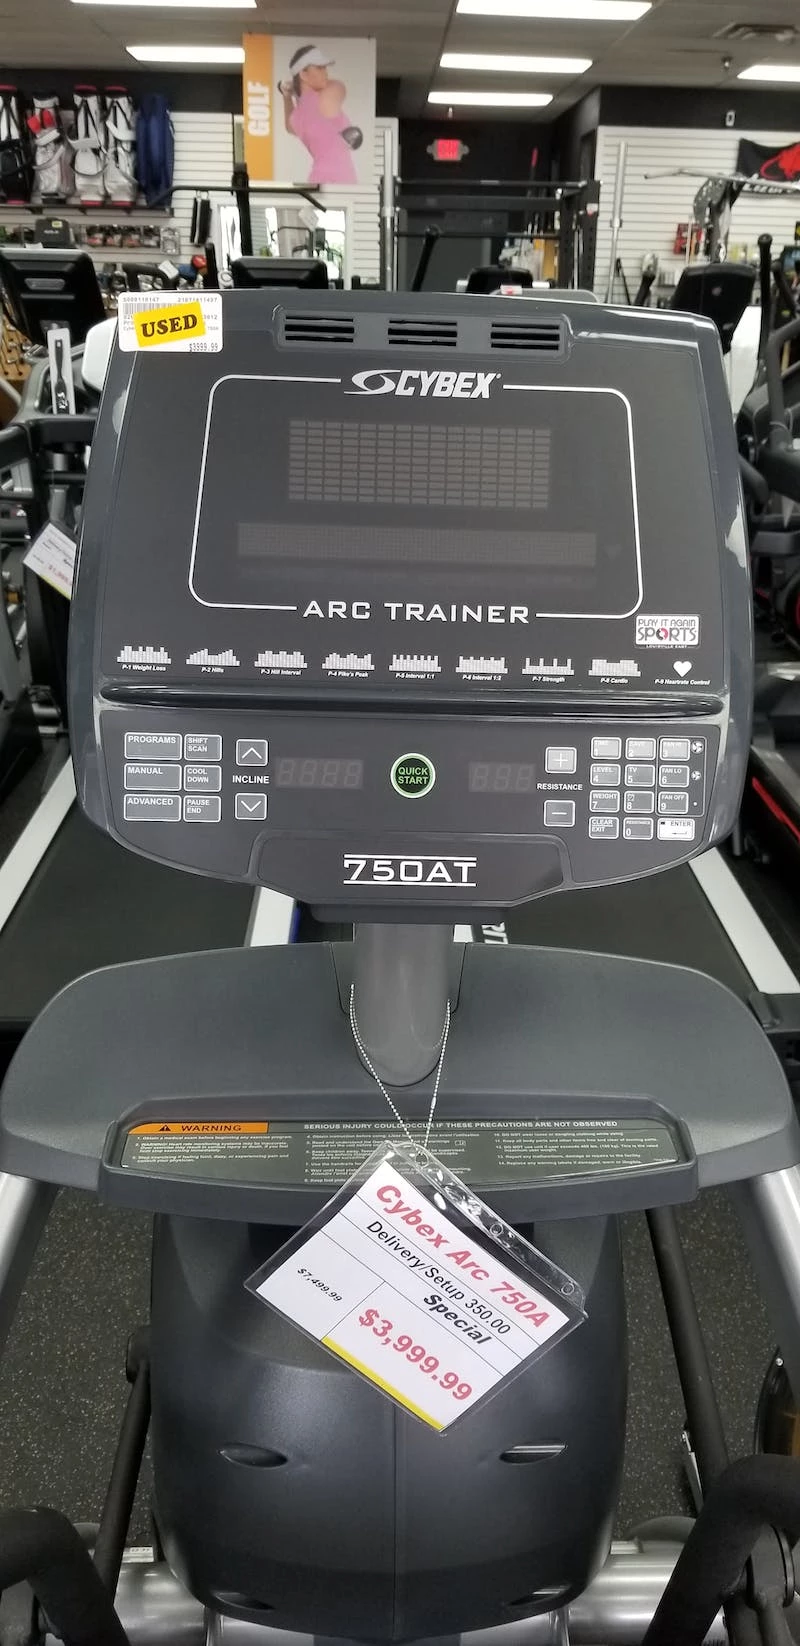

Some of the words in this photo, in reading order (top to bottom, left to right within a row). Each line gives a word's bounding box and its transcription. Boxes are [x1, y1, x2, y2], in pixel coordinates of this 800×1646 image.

[248, 81, 270, 136] GOLF
[141, 314, 197, 338] USED
[395, 370, 496, 398] CYBEX
[303, 600, 371, 619] ARC
[384, 603, 529, 623] TRAINER
[638, 627, 696, 641] SPORTS
[128, 736, 176, 744] PROGRAMS
[232, 775, 270, 784] INCLINE
[398, 767, 428, 776] QUICK
[398, 776, 428, 785] START
[344, 859, 477, 882] 750AT
[376, 1185, 449, 1248] Cybex
[445, 1250, 490, 1282] Arc
[490, 1282, 550, 1328] 750A
[297, 1268, 342, 1302] $7,499.99
[366, 1220, 465, 1302] Delivery/Setup
[465, 1299, 511, 1335] 350.00
[423, 1293, 491, 1346] Special
[359, 1308, 472, 1402] $3,999.99
